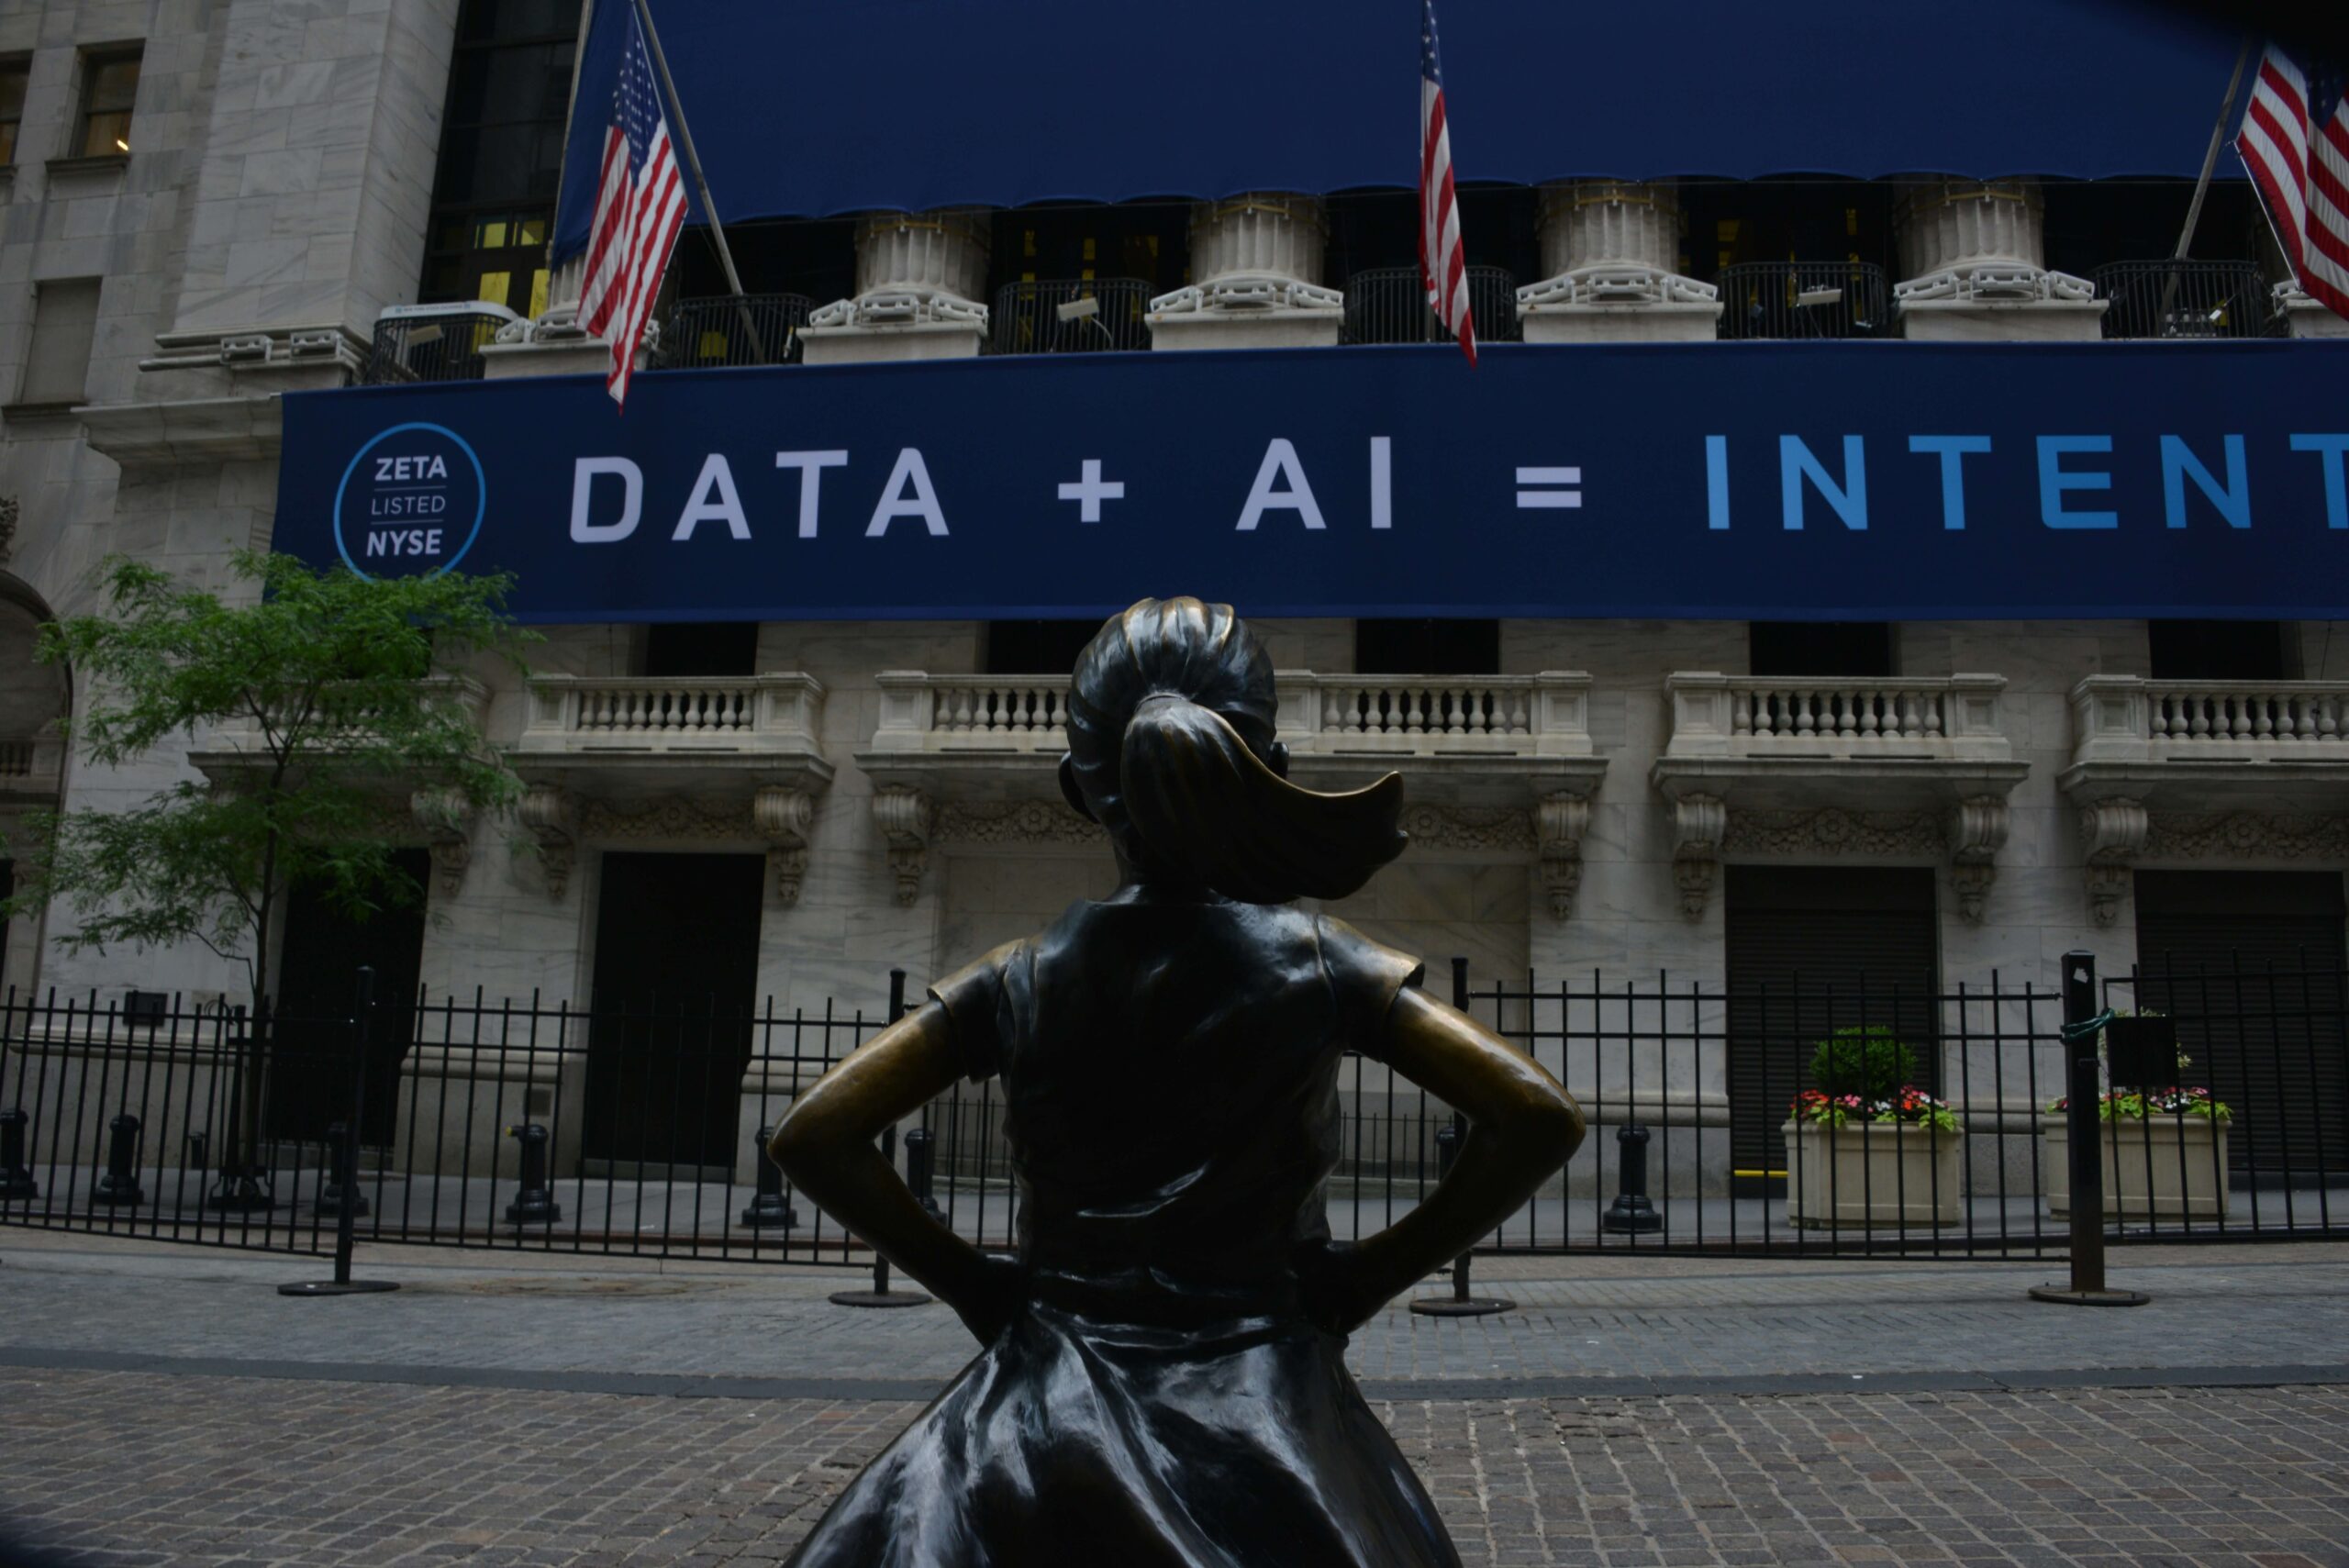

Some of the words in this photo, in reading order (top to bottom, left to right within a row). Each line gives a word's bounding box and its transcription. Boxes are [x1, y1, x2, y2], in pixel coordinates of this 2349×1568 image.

[374, 455, 448, 482] ZETA
[570, 447, 950, 543] DATA
[1057, 459, 1125, 523] +
[1234, 436, 1392, 530] AI
[1515, 466, 1583, 508] =
[1705, 433, 2349, 530] INTENT
[371, 495, 446, 516] LISTED
[366, 528, 443, 557] NYSE
